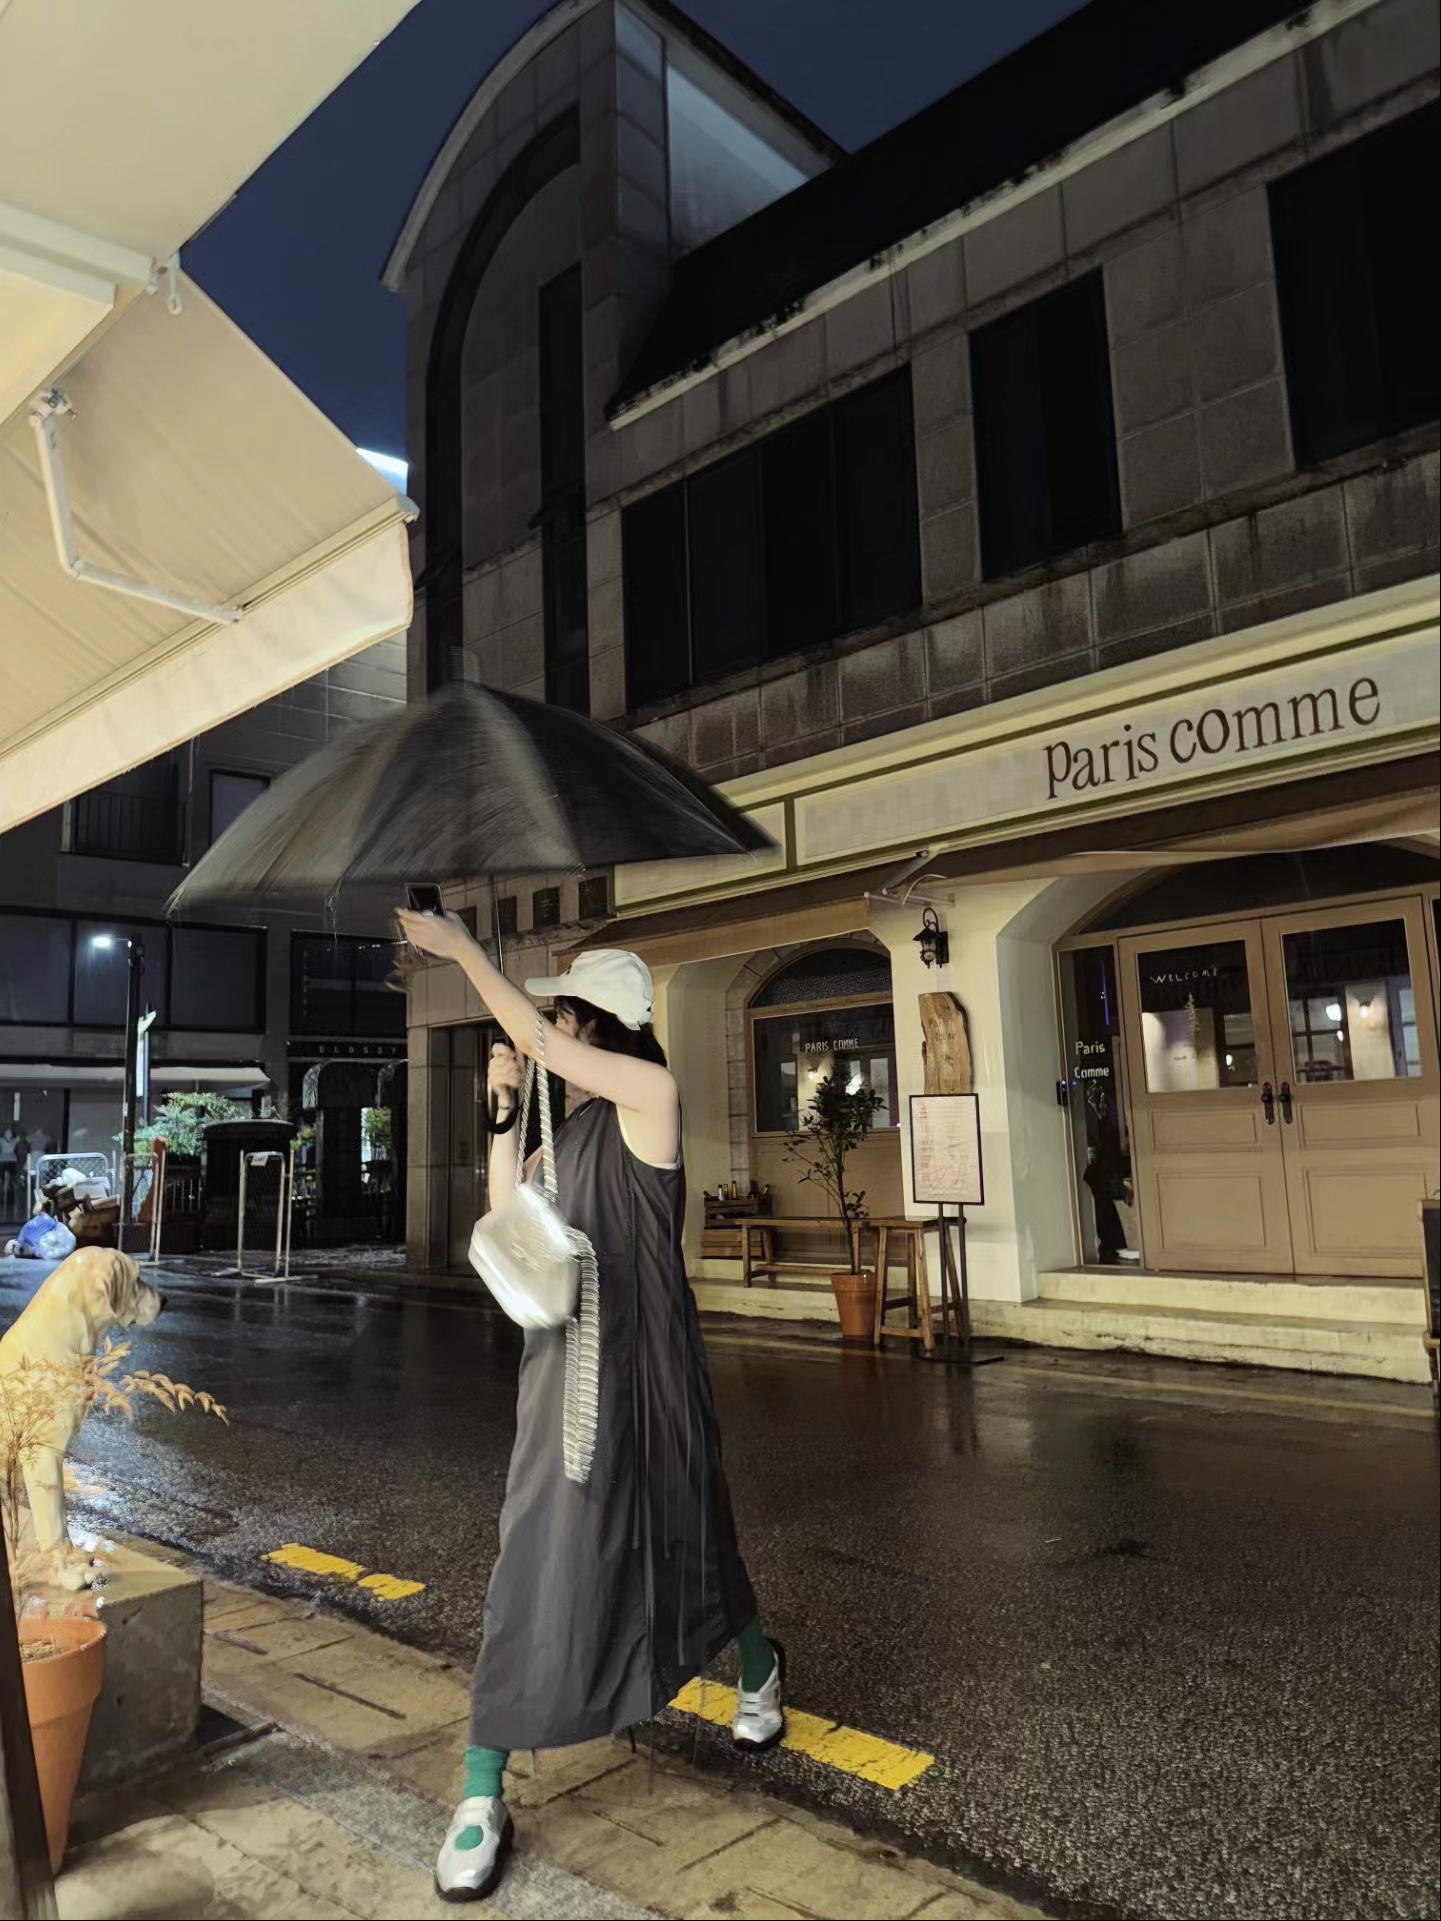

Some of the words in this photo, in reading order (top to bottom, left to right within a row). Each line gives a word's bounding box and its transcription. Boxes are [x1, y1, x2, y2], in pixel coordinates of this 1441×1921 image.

[1170, 677, 1381, 763] comme
[805, 1041, 829, 1053] PARIS
[833, 1038, 859, 1051] COMME
[1075, 1041, 1106, 1056] Paris
[1074, 1066, 1110, 1079] Comme
